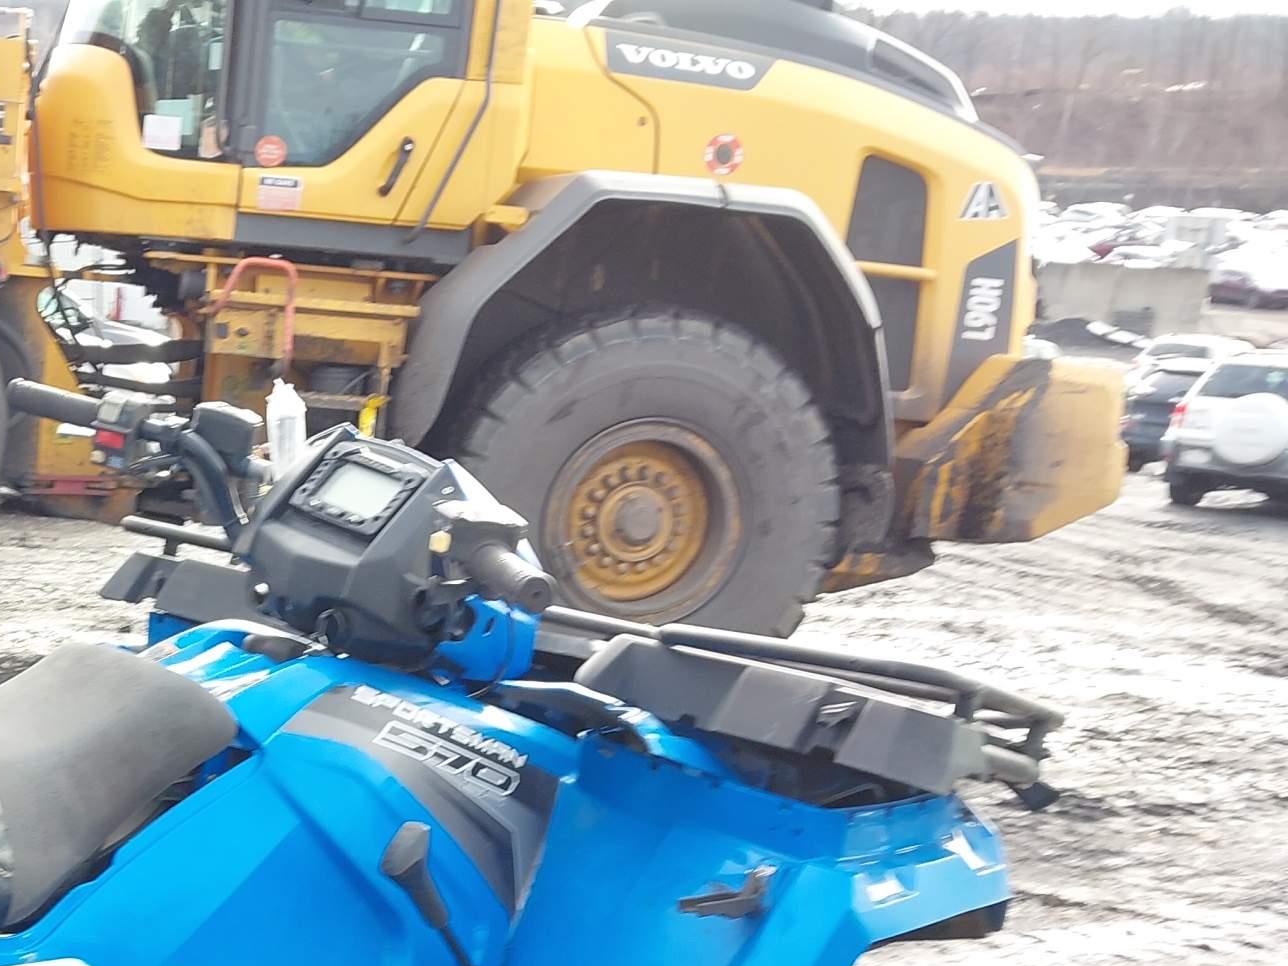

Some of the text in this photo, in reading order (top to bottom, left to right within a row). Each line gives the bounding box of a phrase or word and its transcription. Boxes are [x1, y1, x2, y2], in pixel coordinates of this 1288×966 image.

[615, 43, 757, 80] VOLVO
[961, 276, 1006, 341] L90H
[350, 684, 529, 769] SPORTSMAN
[372, 719, 521, 797] 570
